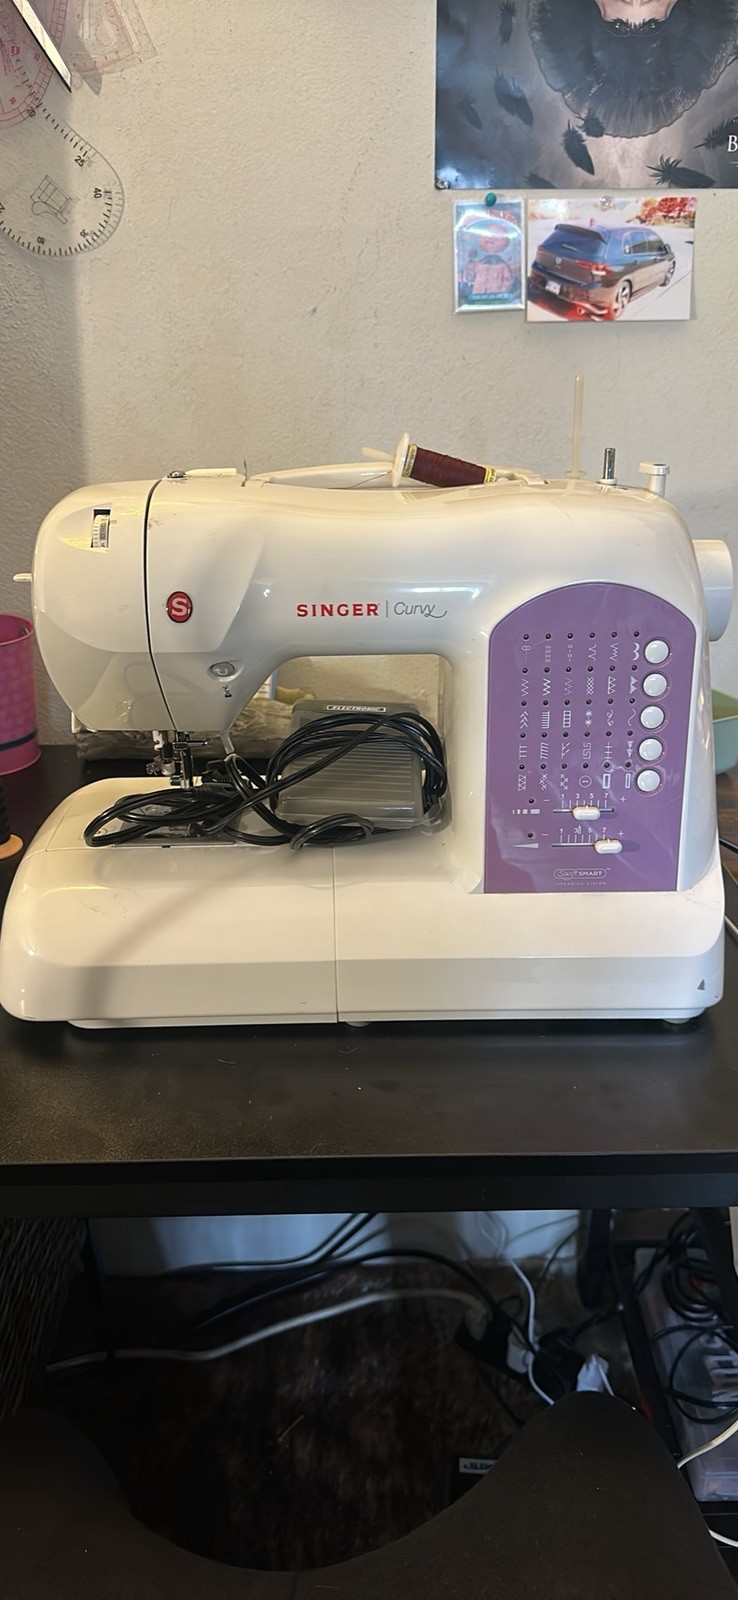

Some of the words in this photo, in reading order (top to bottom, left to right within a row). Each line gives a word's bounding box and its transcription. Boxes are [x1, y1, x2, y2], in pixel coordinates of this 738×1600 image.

[74, 155, 85, 167] 25
[93, 187, 103, 199] 40
[171, 597, 189, 616] S
[296, 603, 379, 617] SINGER
[393, 601, 448, 619] Curvy
